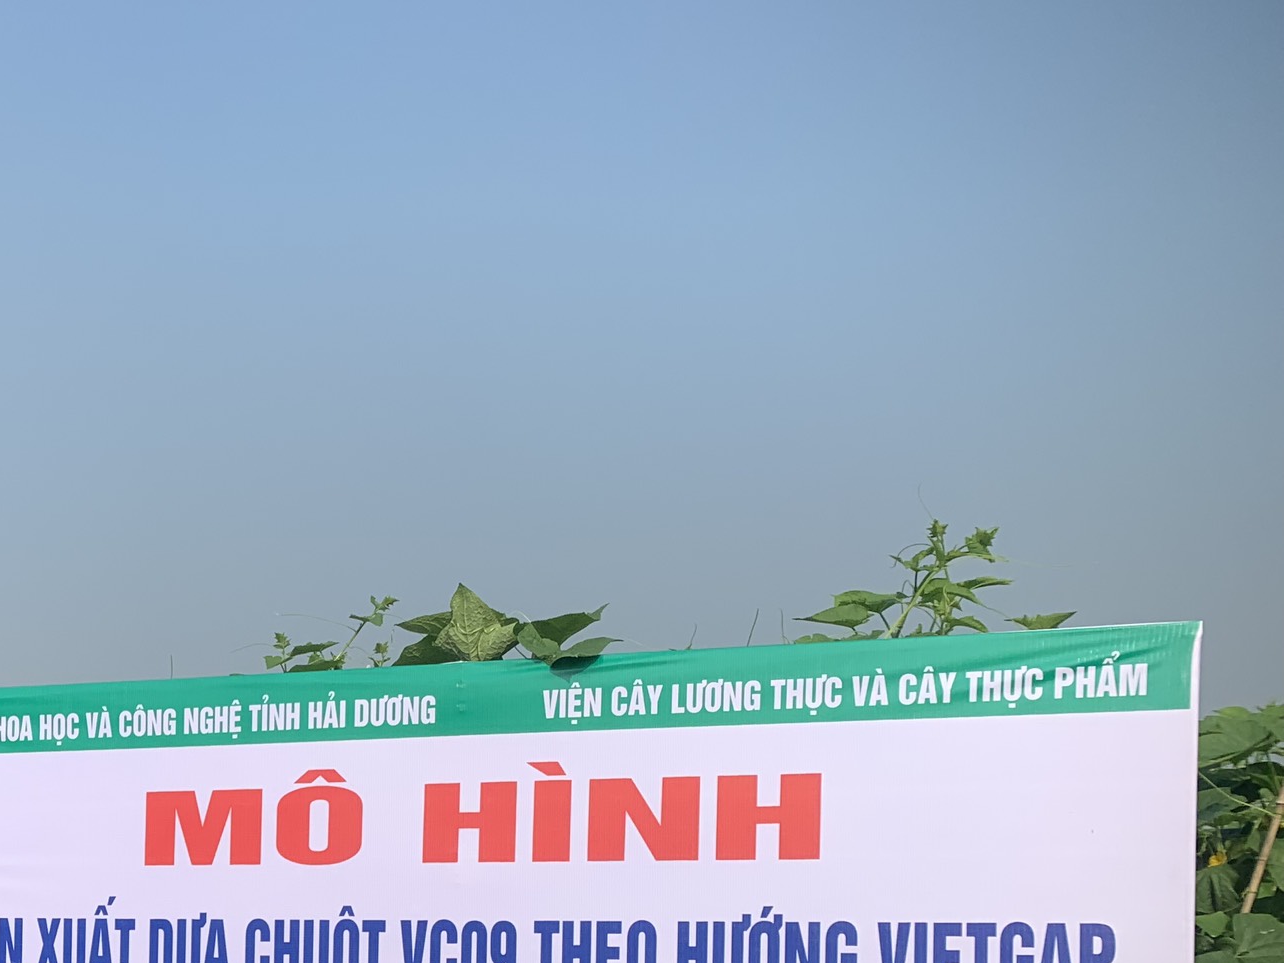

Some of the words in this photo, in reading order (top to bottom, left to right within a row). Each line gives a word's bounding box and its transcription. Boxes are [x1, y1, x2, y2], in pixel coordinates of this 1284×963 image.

[39, 712, 80, 746] HỌC
[86, 706, 113, 738] VÀ
[118, 704, 177, 738] CÔNG
[183, 700, 242, 739] NGHỆ
[248, 695, 301, 732] TỈNH
[307, 690, 347, 730] HẢI
[353, 694, 436, 728] DƯƠNG
[542, 682, 603, 725] VIỆN
[611, 679, 664, 717] CÂY
[671, 678, 762, 715] LƯƠNG
[770, 674, 843, 716] THỰC
[852, 668, 889, 707] VÀ
[898, 666, 957, 706] CÂY
[965, 665, 1044, 709] THỰC
[1054, 651, 1149, 700] PHẨM
[144, 769, 363, 867] MÔ
[422, 761, 822, 864] HÌNH
